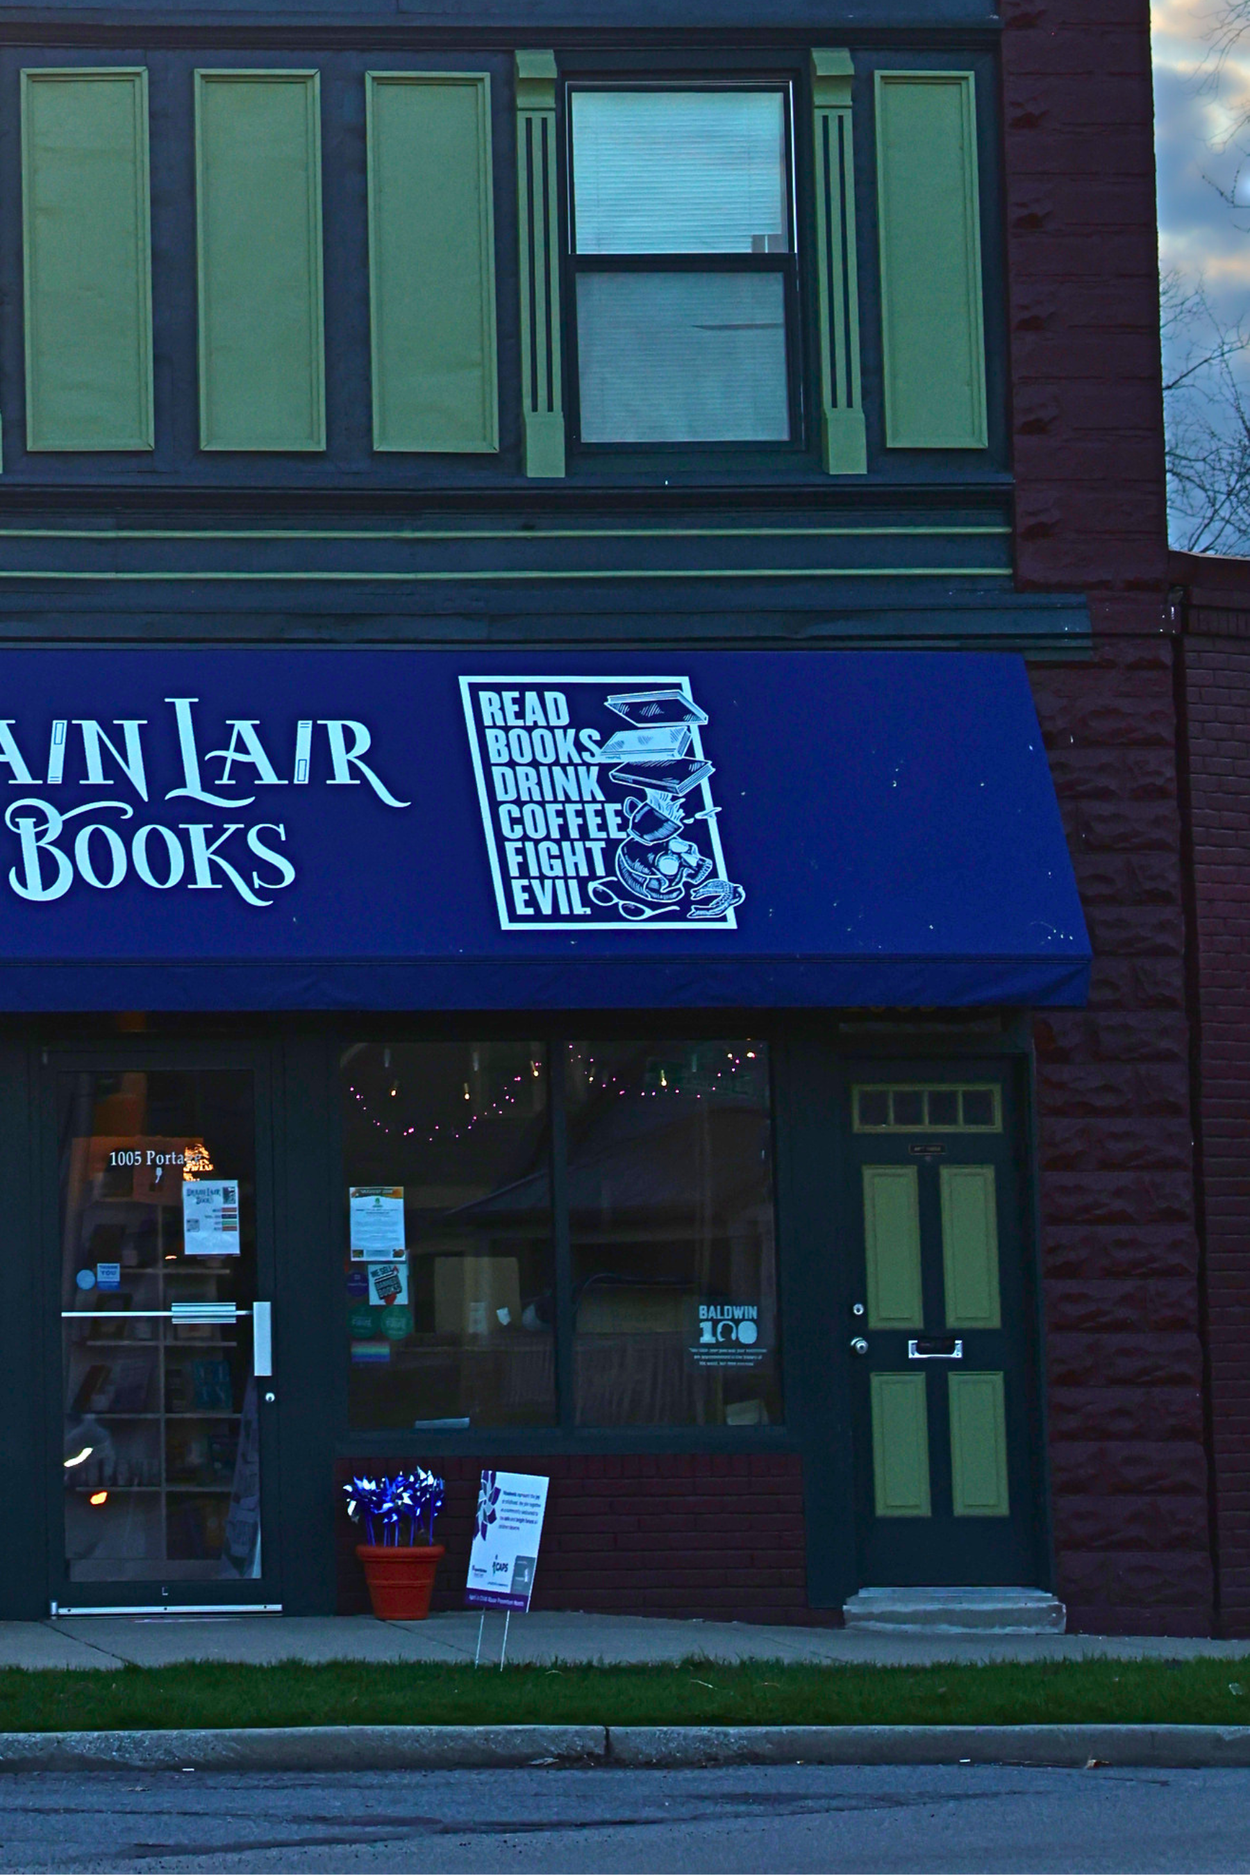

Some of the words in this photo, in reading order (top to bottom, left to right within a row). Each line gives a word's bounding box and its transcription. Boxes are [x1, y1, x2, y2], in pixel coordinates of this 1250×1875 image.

[478, 691, 570, 726] READ
[485, 728, 602, 765] BOOKS
[491, 766, 606, 801] DRINK
[498, 803, 627, 839] COFFEE
[504, 841, 606, 877] FIGHT
[511, 879, 592, 915] EVIL
[110, 1151, 142, 1166] 1005
[146, 1150, 202, 1167] Portae
[699, 1305, 758, 1319] BALDWIN
[699, 1320, 758, 1345] 100
[495, 1562, 508, 1572] CAPS
